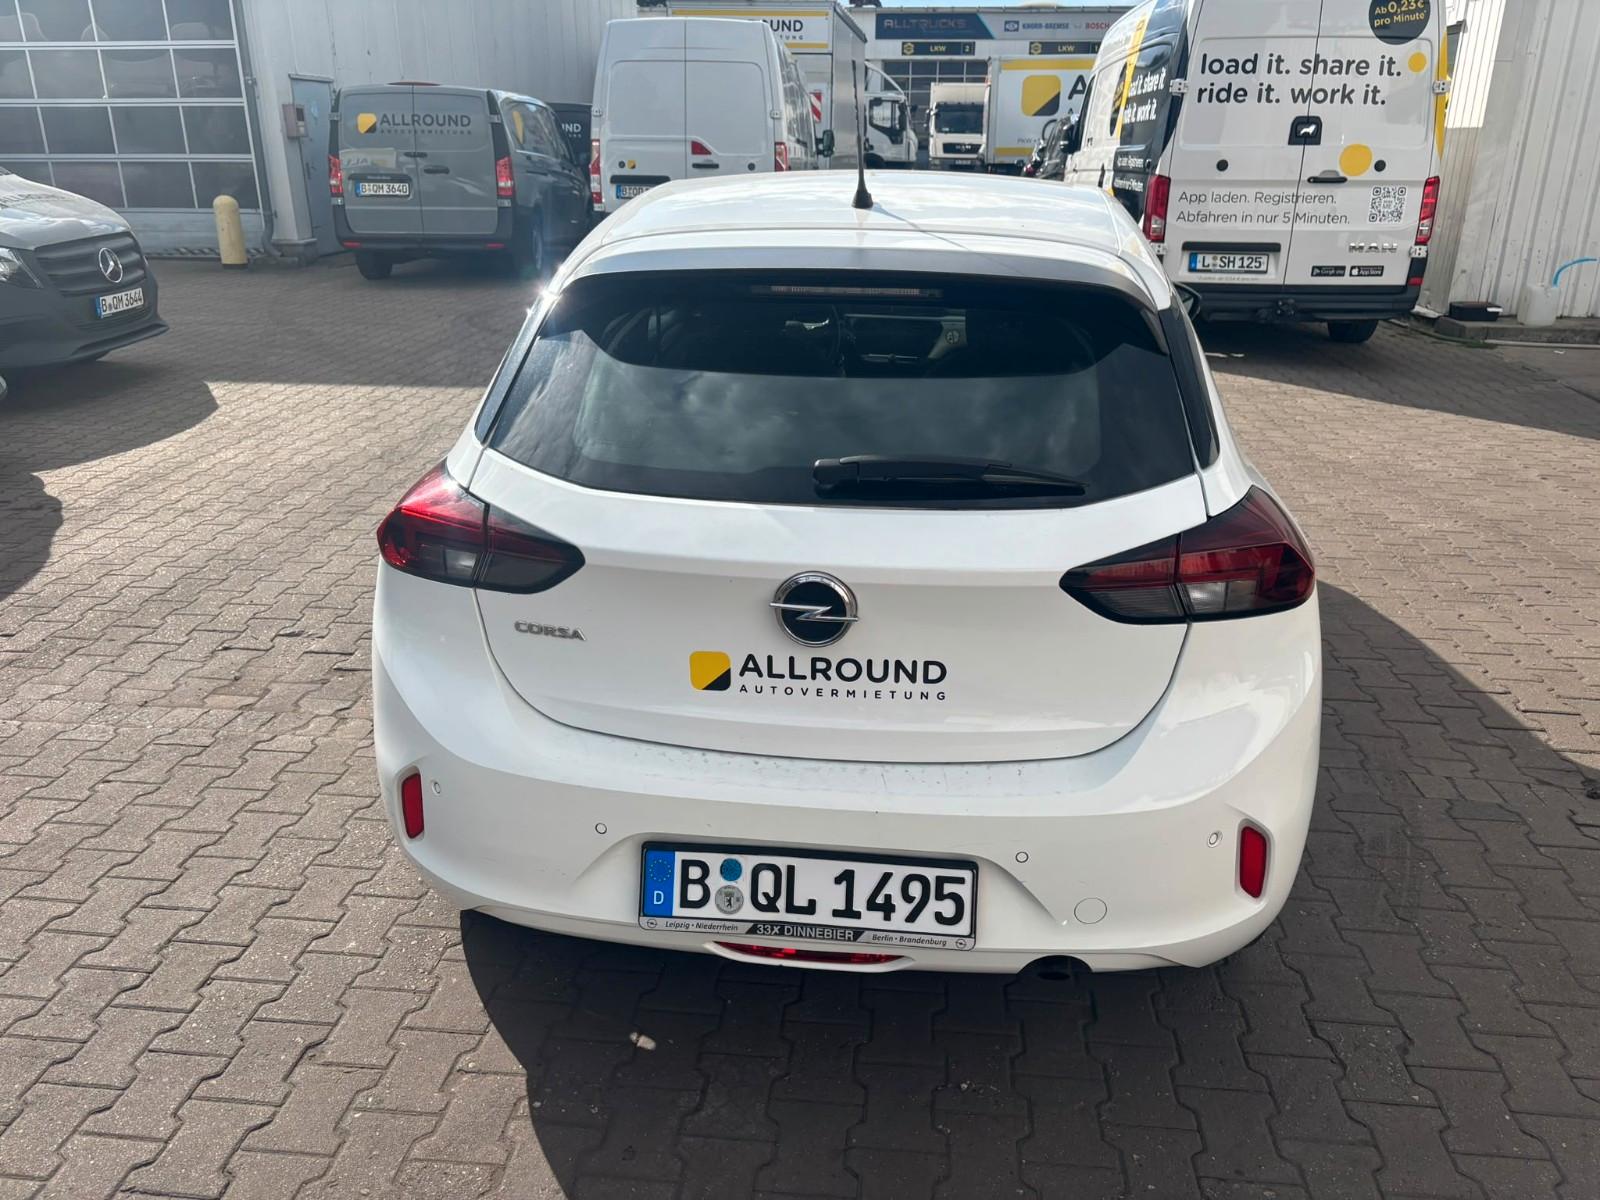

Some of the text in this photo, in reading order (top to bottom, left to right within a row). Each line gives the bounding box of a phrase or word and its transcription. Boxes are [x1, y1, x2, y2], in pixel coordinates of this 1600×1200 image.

[1375, 6, 1387, 15] Ab
[762, 19, 803, 32] UND
[884, 19, 968, 29] ALLTRUCKS
[1085, 22, 1110, 30] BOSCH
[1374, 18, 1391, 27] pro
[1200, 53, 1401, 77] load it. share it.
[1197, 82, 1386, 105] ride it. work it.
[380, 113, 472, 128] ALLROUND
[562, 123, 582, 133] ND
[385, 184, 408, 194] 3640
[1178, 191, 1337, 205] App laden. Registrieren.
[1176, 211, 1350, 225] Abfahren in nur 5 Minuten.
[1348, 242, 1398, 253] MAN
[1202, 255, 1262, 269] L SH 125
[101, 289, 143, 313] B QM 3644
[514, 620, 587, 642] CORSA
[739, 653, 948, 684] ALLROUND
[739, 684, 947, 700] AUTOVERMIETUNG
[653, 890, 665, 905] D
[679, 858, 967, 926] B QL 1495
[665, 920, 739, 932] Leipzig Niederrhein
[783, 925, 855, 941] DINNEBIER
[872, 934, 947, 947] Berlin Brandenburg
